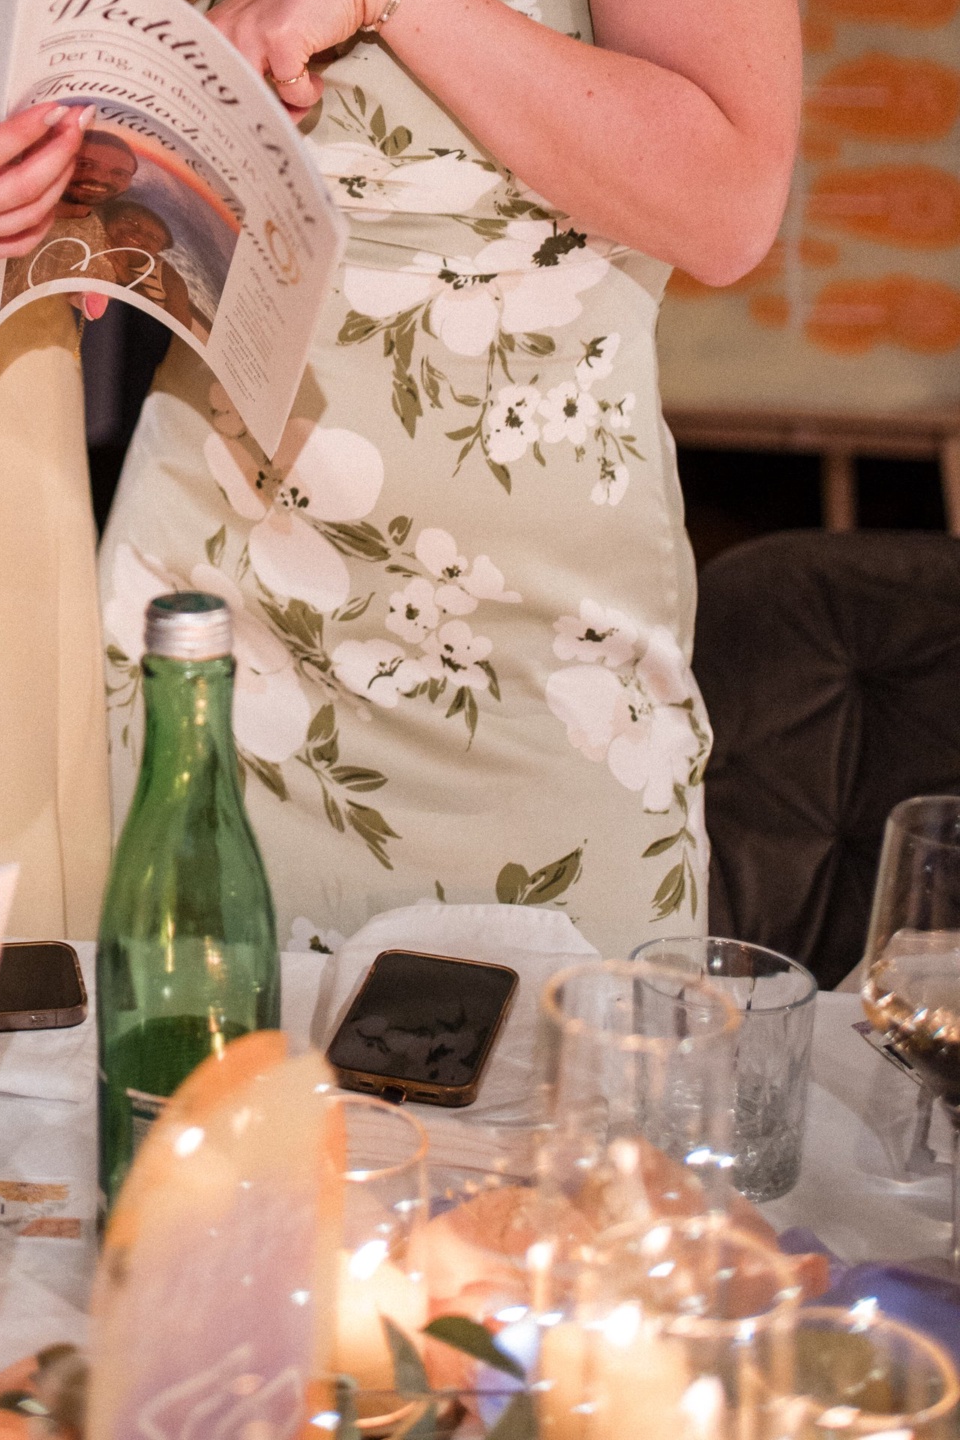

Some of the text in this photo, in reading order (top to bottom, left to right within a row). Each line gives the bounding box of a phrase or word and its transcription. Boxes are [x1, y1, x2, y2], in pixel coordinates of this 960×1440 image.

[49, 51, 88, 67] Der
[95, 50, 133, 71] Tag,
[142, 70, 165, 86] an
[171, 85, 208, 121] dem
[31, 73, 238, 181] Traumhochzeit
[94, 106, 177, 151] Karo
